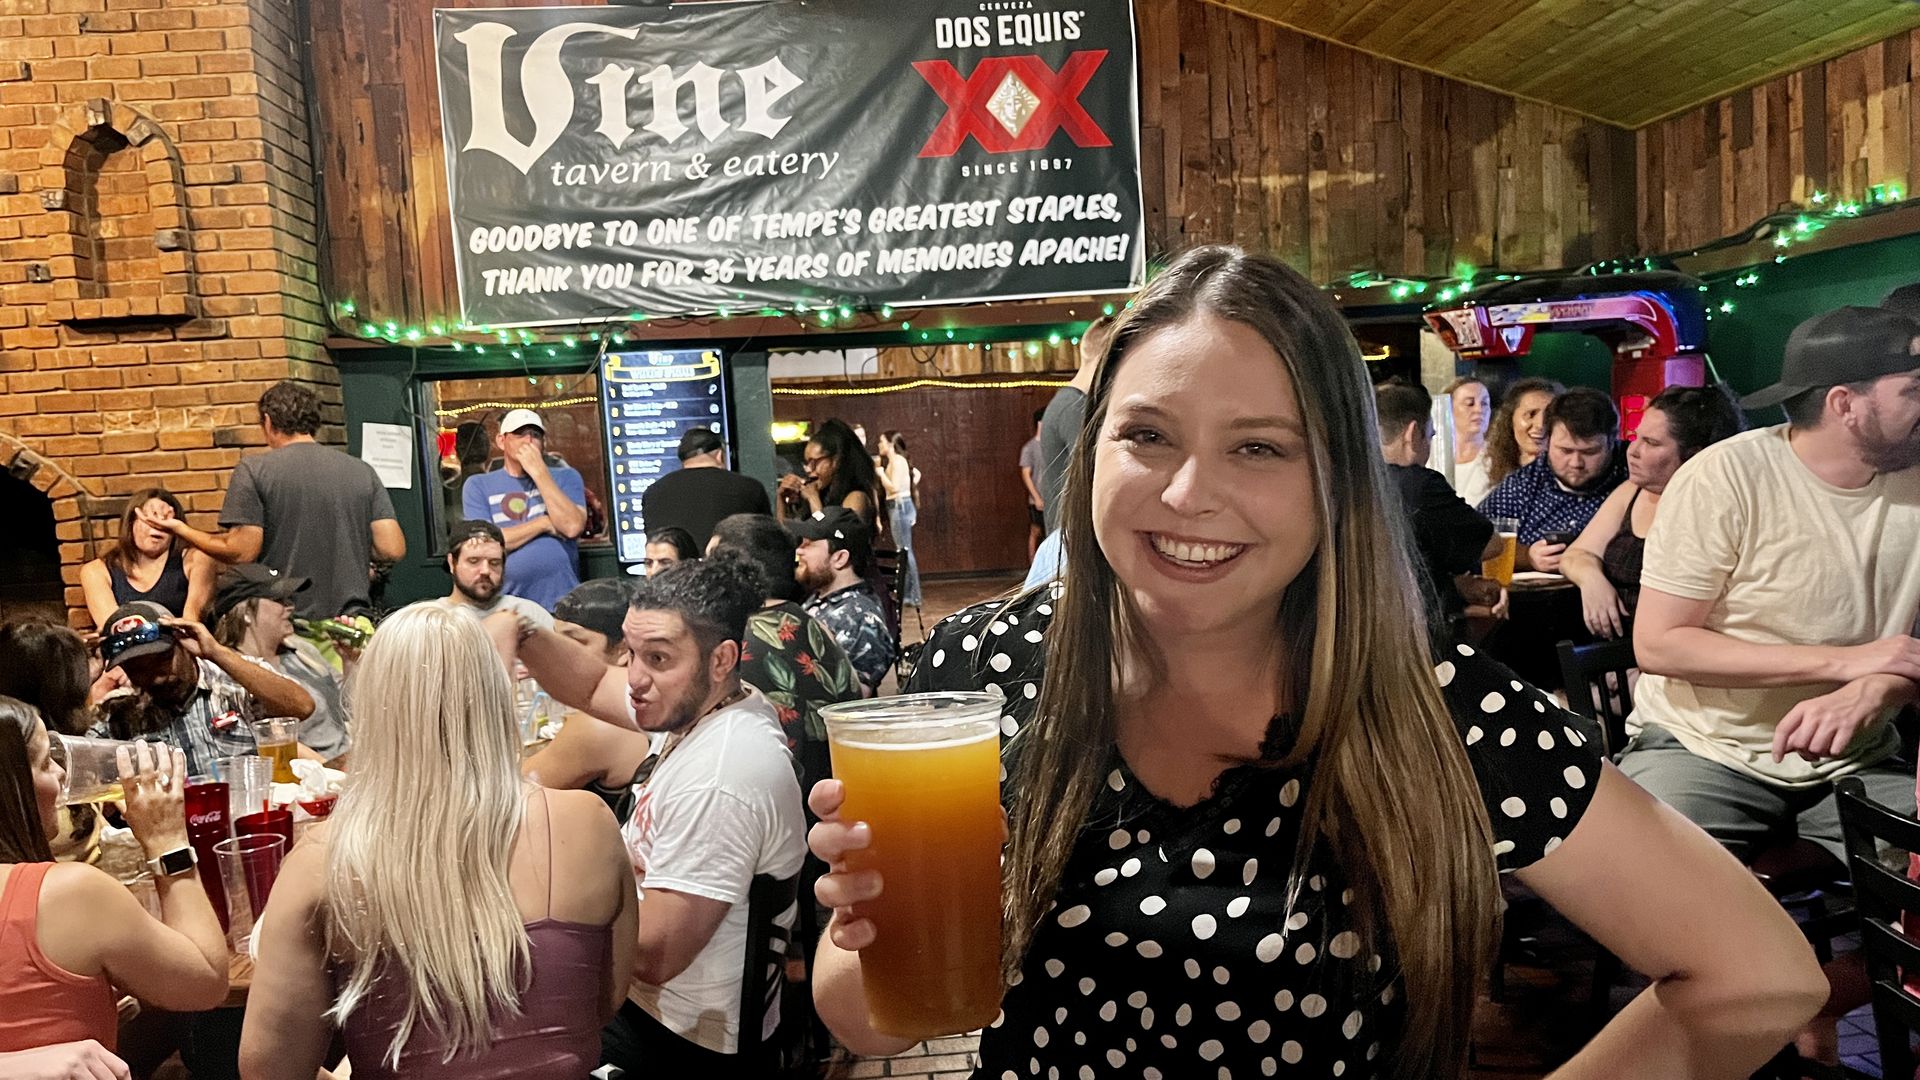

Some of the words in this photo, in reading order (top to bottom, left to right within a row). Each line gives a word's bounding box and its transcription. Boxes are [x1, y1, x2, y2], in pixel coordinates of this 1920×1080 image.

[979, 1, 1033, 11] CERVEZA
[935, 16, 991, 48] DOS
[997, 10, 1085, 47] EQUIS
[453, 22, 805, 176] Vine
[551, 158, 673, 187] tavern
[684, 152, 712, 180] &
[723, 150, 840, 180] eatery
[961, 161, 1019, 177] SINCE
[469, 222, 595, 255] GOODBYE
[602, 219, 640, 246] TO
[646, 217, 700, 244] ONE
[707, 214, 744, 242] OF
[750, 207, 861, 240] TEMPE'S
[868, 199, 1001, 234] GREATEST
[1006, 192, 1122, 224] STAPLES,
[482, 266, 574, 296] THANK
[580, 263, 634, 290] YOU
[640, 260, 694, 288] FOR
[702, 258, 735, 284] 36
[745, 252, 829, 281] YEARS
[836, 250, 871, 277] OF
[876, 240, 1014, 275] MEMORIES
[1018, 233, 1130, 266] APACHE!
